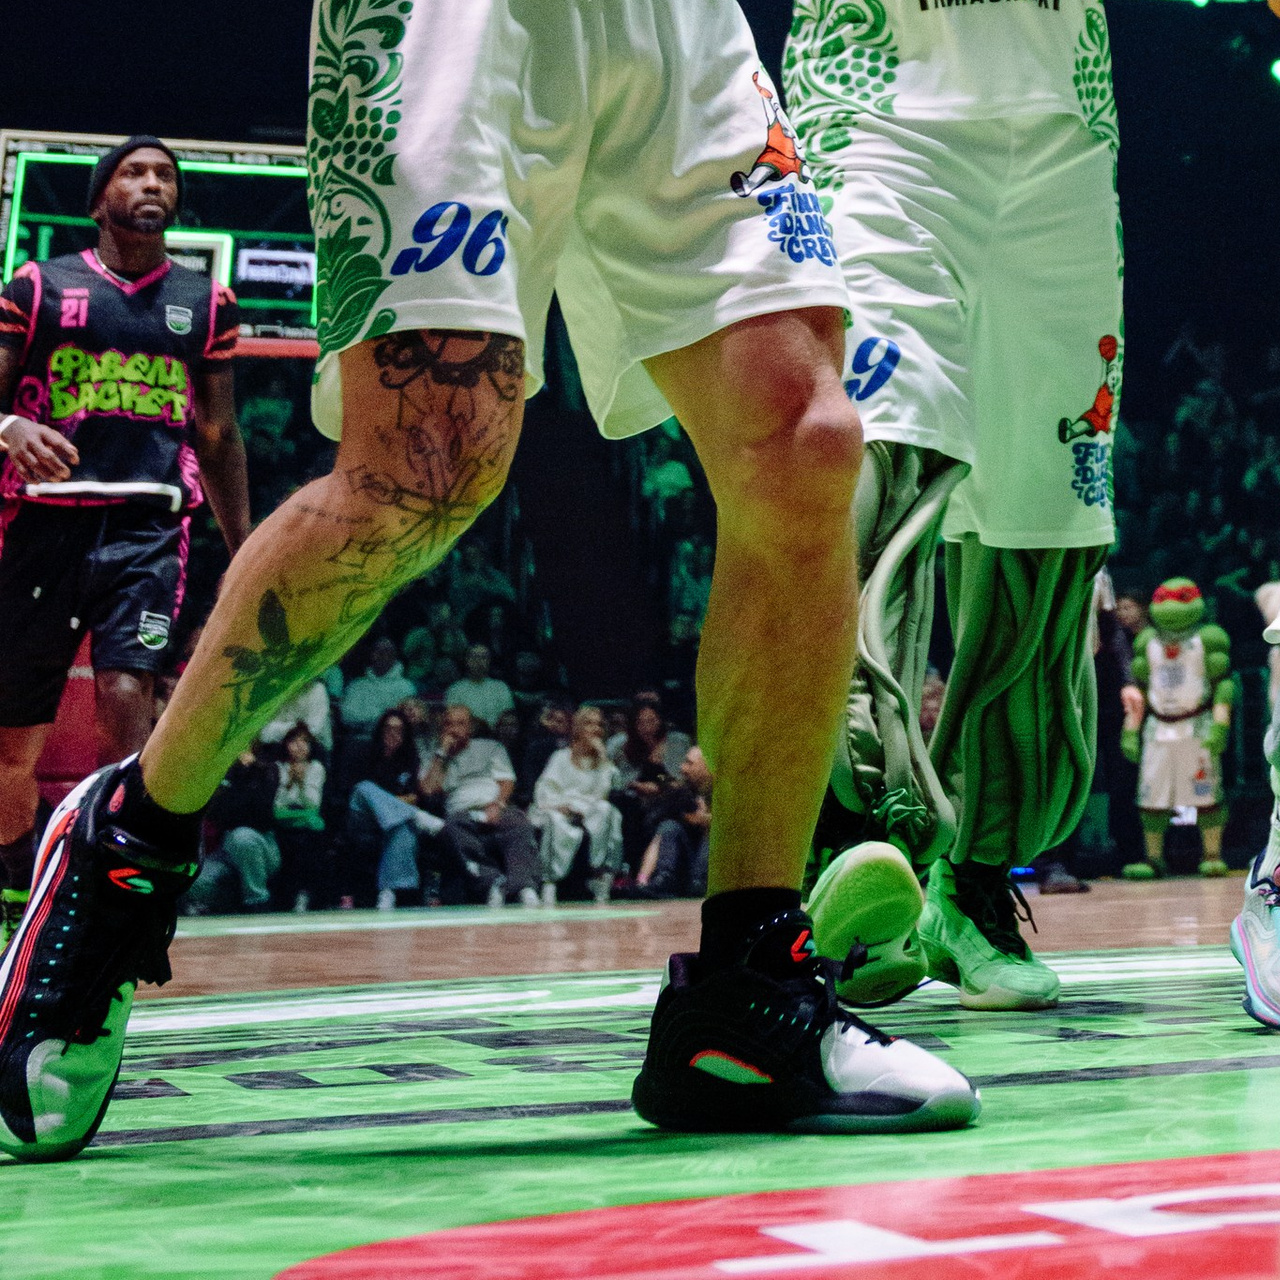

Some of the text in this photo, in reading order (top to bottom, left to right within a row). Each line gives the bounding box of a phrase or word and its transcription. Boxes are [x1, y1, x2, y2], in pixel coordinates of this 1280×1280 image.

[390, 201, 509, 276] 96
[60, 297, 90, 329] 21
[845, 336, 902, 401] 9
